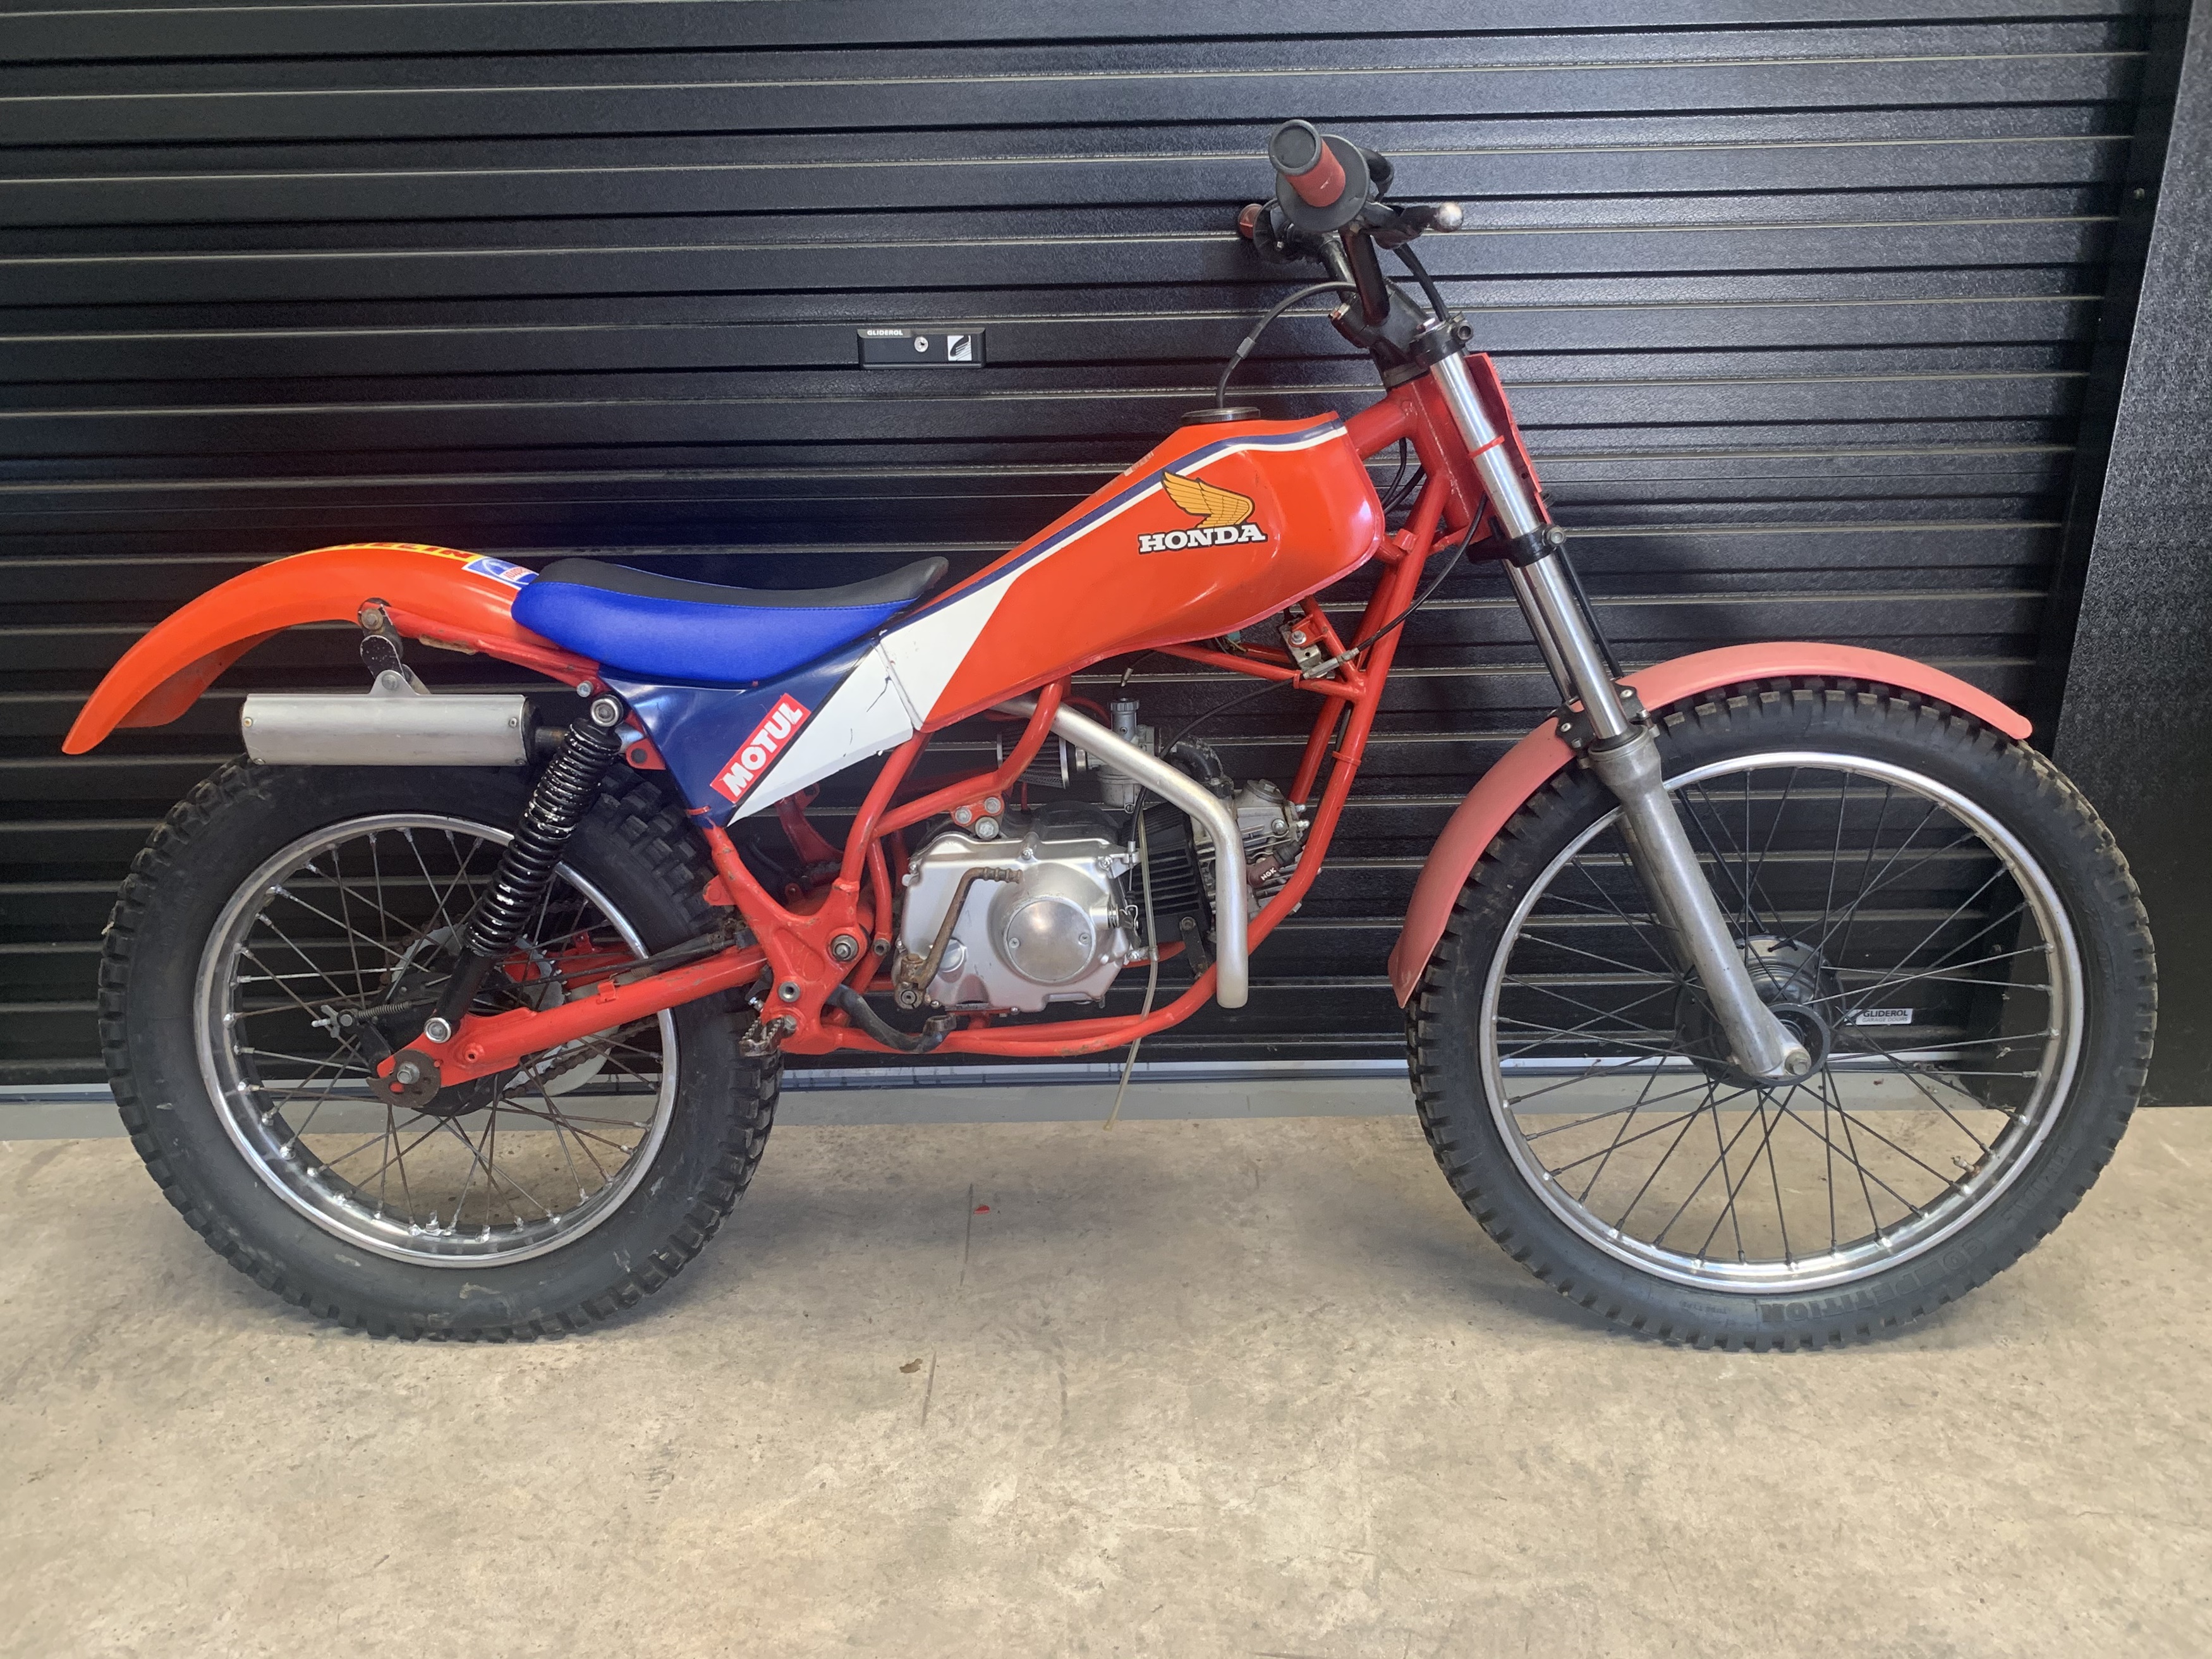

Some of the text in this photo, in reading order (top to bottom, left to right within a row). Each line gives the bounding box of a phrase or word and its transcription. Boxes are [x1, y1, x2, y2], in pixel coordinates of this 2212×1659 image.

[1139, 524, 1266, 552] HONDA
[722, 702, 803, 798] MOTUL
[1260, 867, 1277, 881] NGK
[1761, 1237, 1987, 1322] COMPETITION
